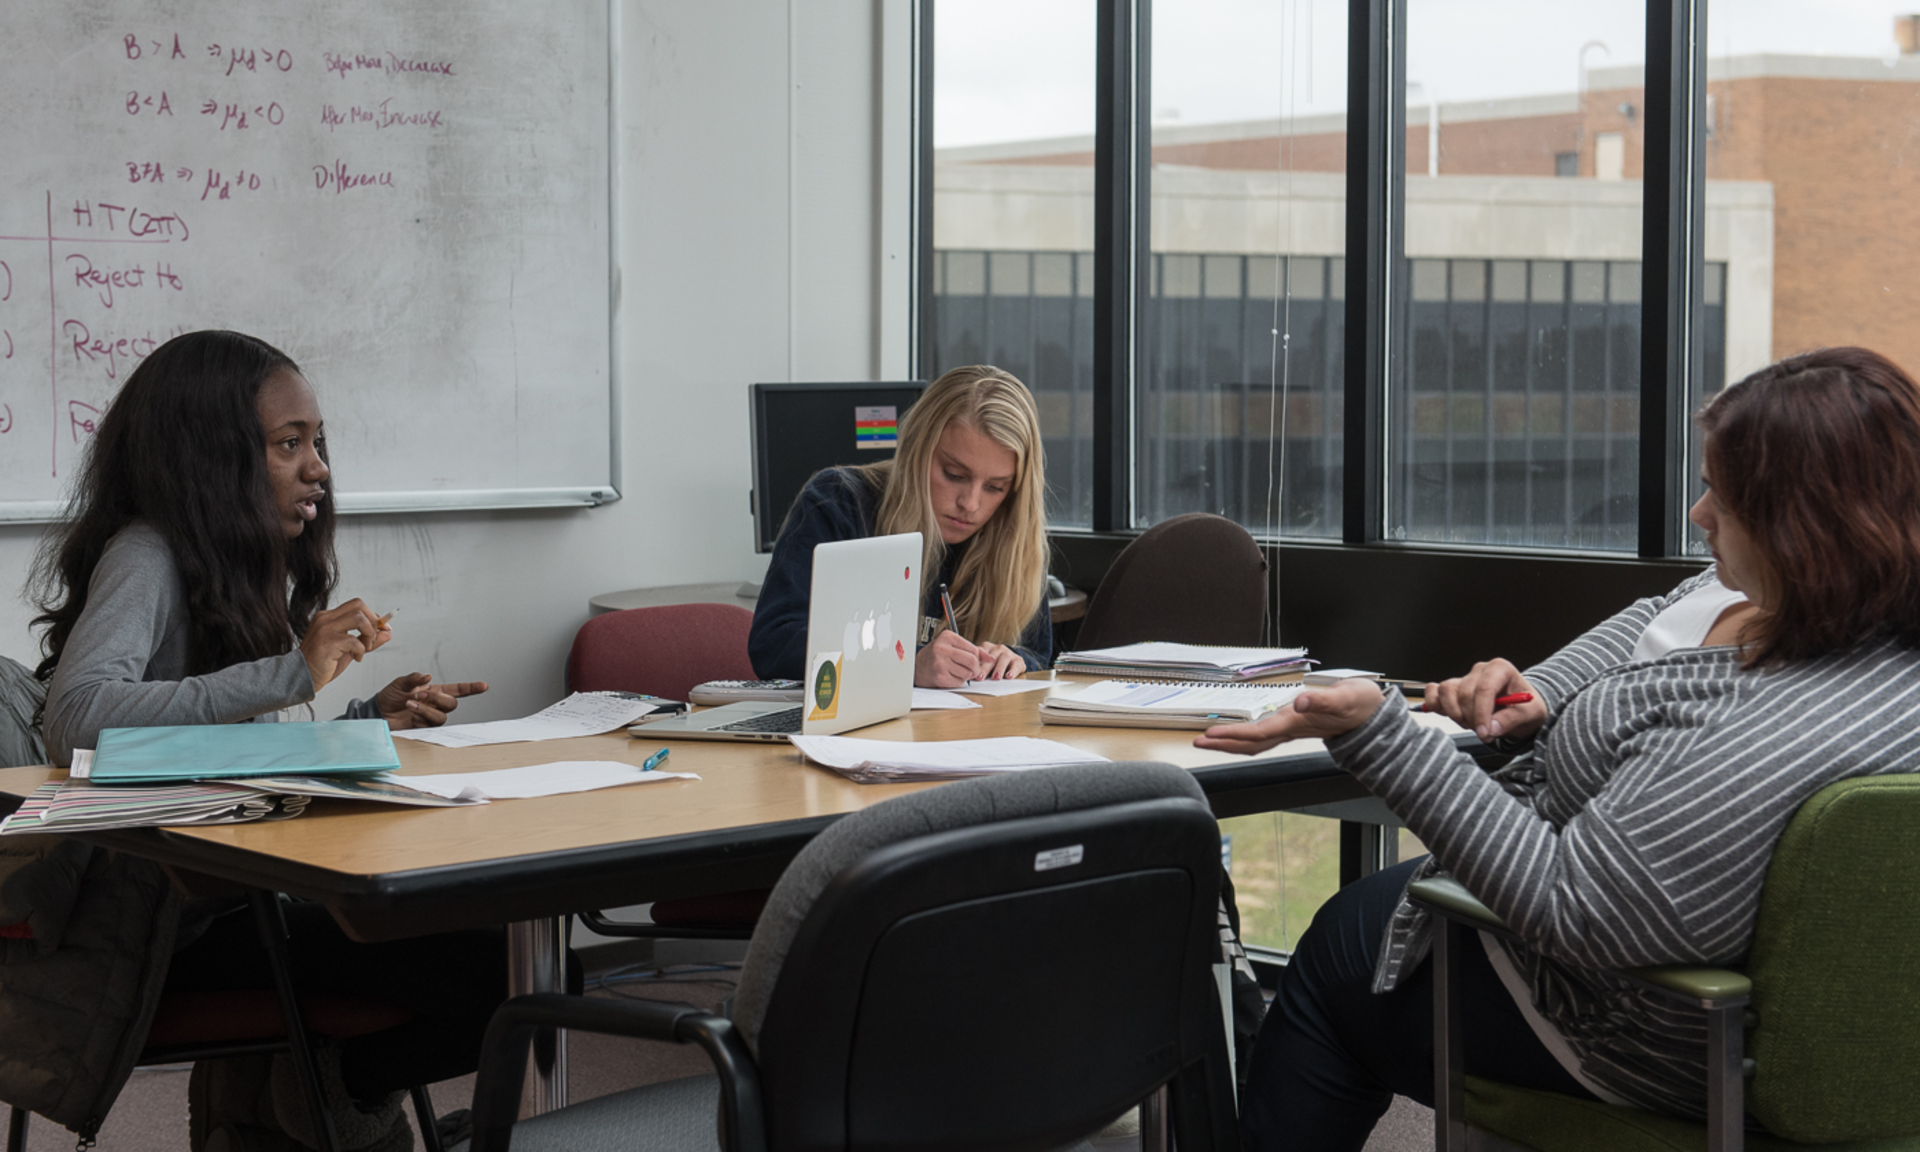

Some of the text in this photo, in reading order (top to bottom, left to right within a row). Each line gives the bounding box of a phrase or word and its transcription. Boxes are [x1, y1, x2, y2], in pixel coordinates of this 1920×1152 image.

[312, 158, 395, 195] Difference
[65, 253, 145, 309] Reject
[62, 319, 157, 379] Reject
